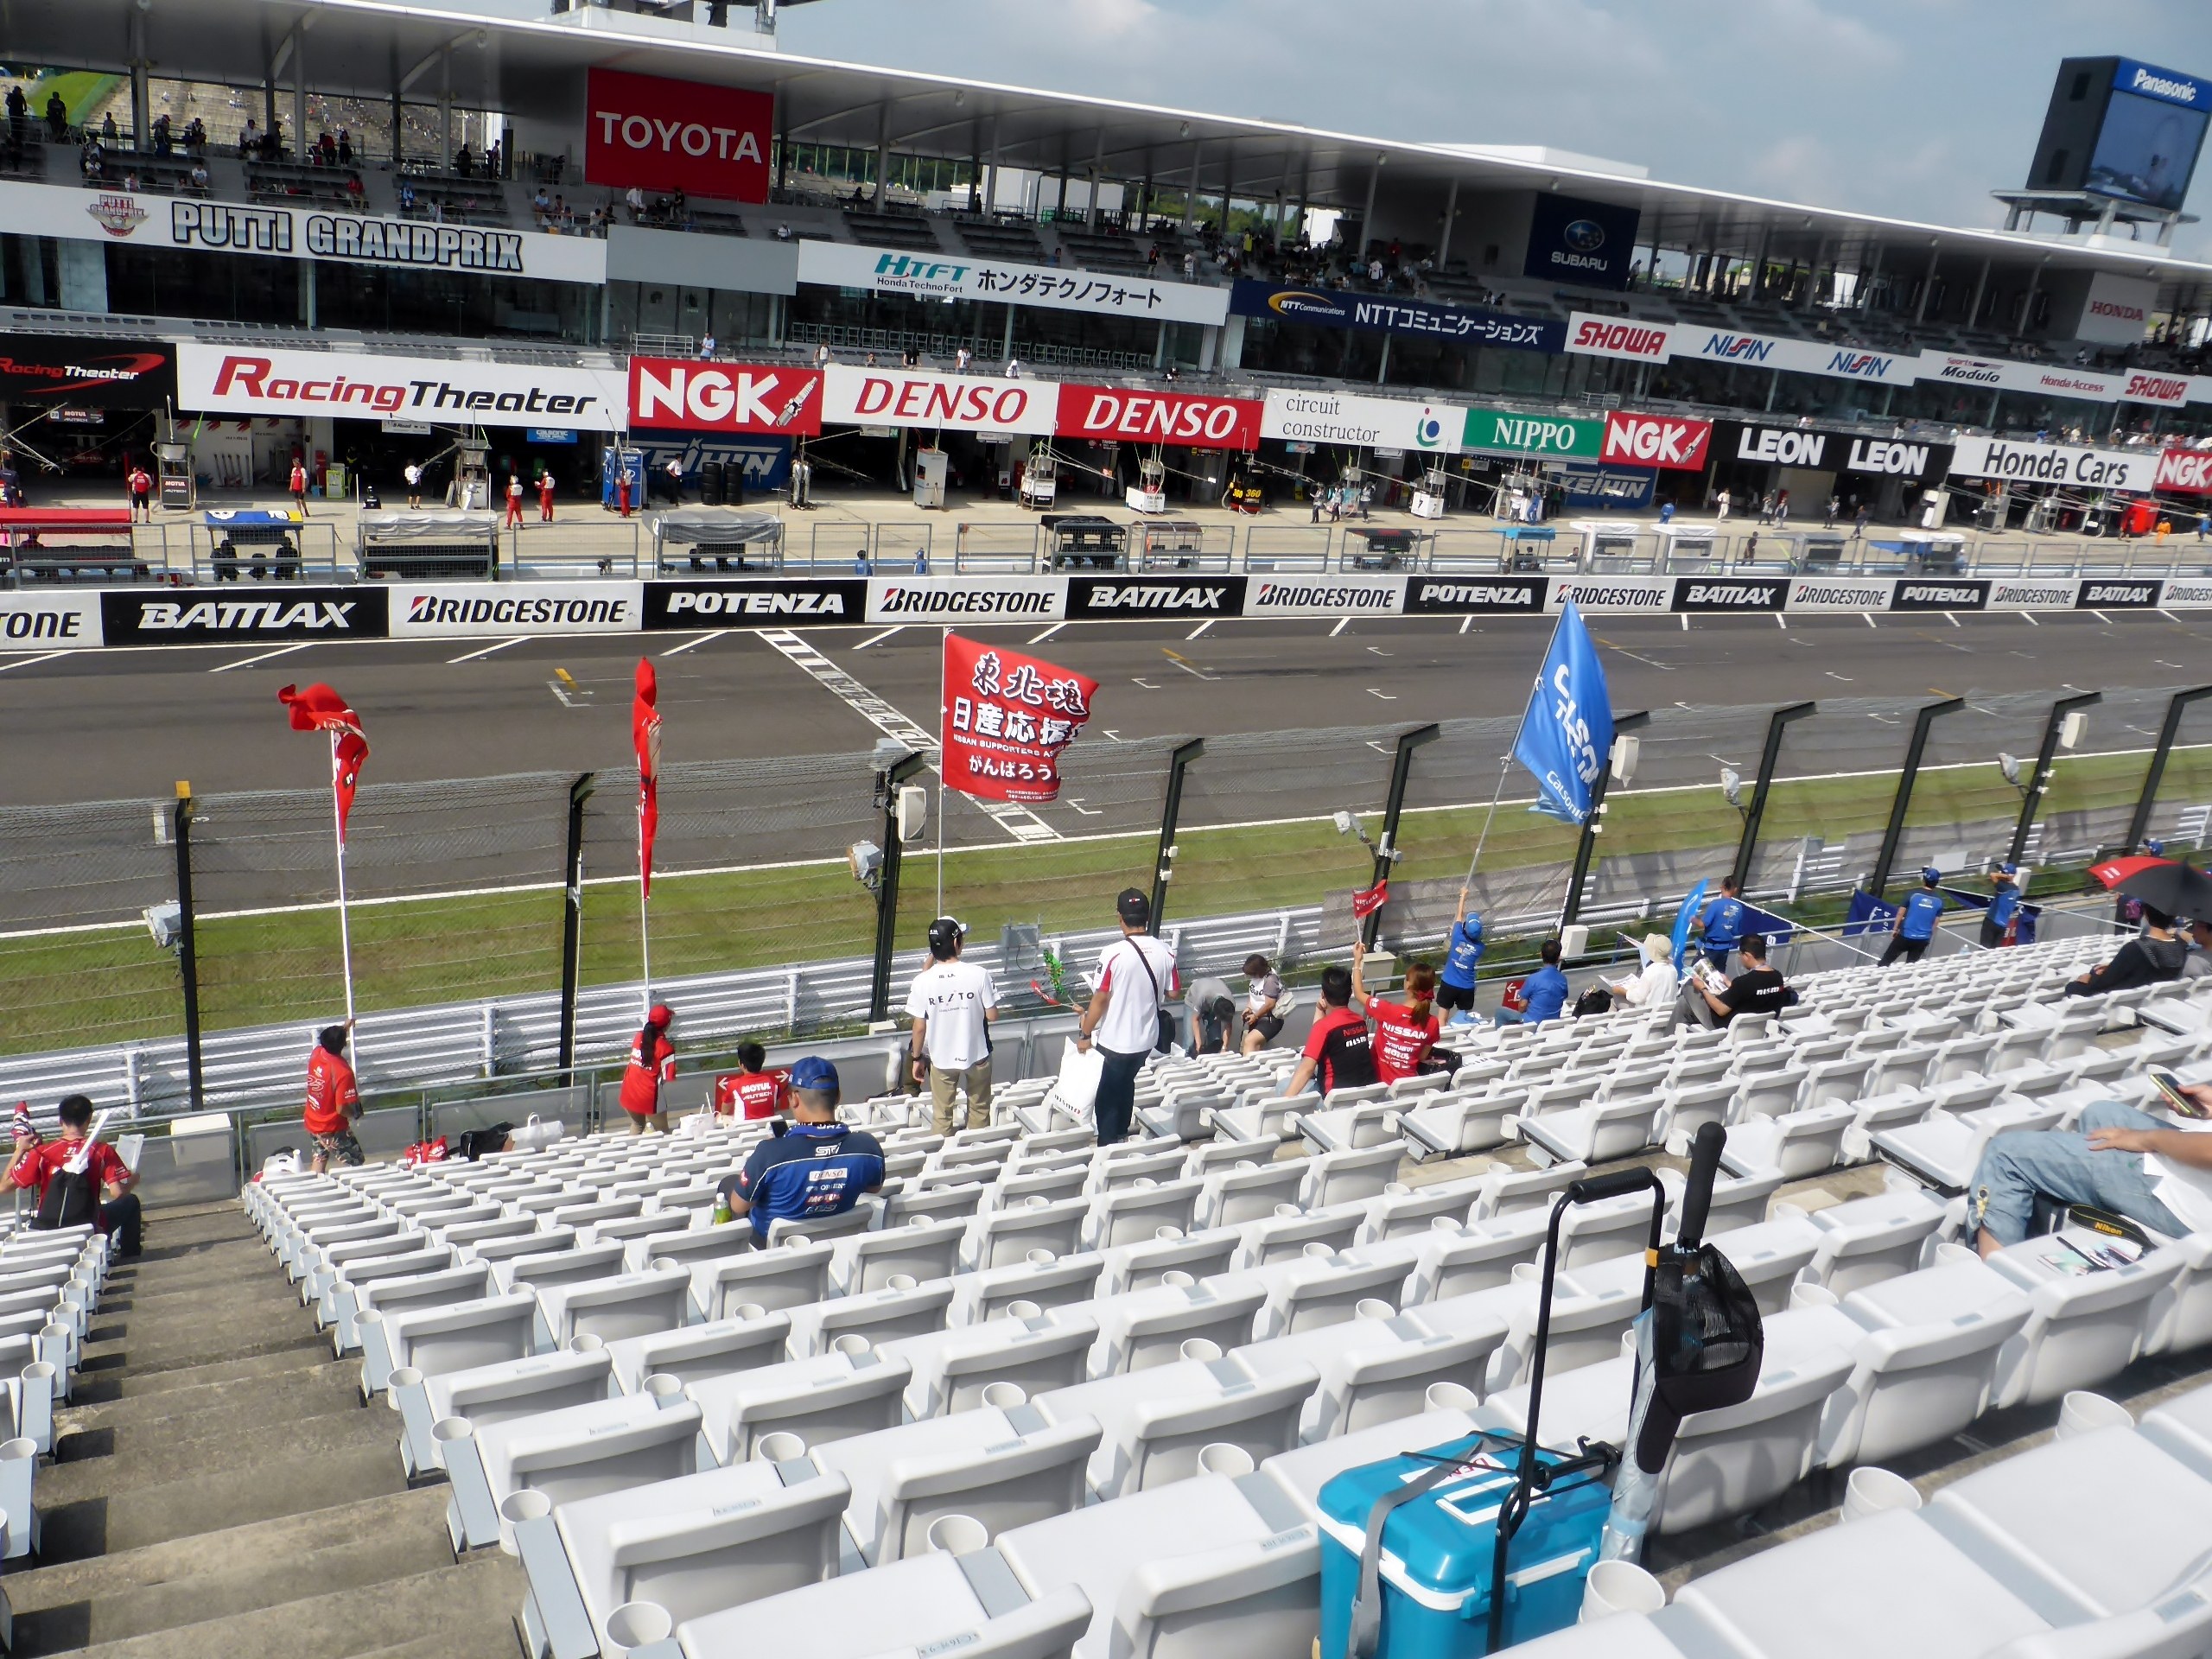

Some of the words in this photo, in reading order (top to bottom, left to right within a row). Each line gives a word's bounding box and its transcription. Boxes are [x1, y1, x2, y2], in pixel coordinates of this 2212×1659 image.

[2133, 68, 2196, 102] Panasonic
[596, 111, 762, 164] TOYOTA
[99, 194, 134, 208] PUTTI
[172, 201, 292, 251] PUTTI
[307, 215, 523, 272] GRANDPRIX
[874, 254, 971, 282] HTFT
[1551, 251, 1608, 271] SUBARU
[877, 276, 907, 288] Honda
[978, 270, 1161, 308] ホンダテクノフォート
[1281, 300, 1300, 310] NTT
[1300, 303, 1345, 316] Communications
[2089, 301, 2144, 322] HONDA
[1356, 302, 1543, 345] NTTコミュニケーションズ
[1573, 321, 1667, 356] SHOWA
[1947, 357, 1974, 366] Sports
[1941, 365, 2001, 383] Modulo
[2040, 374, 2072, 389] Honda
[2072, 379, 2104, 392] Access
[639, 367, 779, 426] NGK
[2125, 375, 2188, 400] SHOWA
[855, 378, 1027, 423] DENSO
[1286, 395, 1340, 416] circuit
[1084, 392, 1238, 439] DENSO
[1282, 418, 1381, 443] constructor
[1492, 418, 1576, 450] NIPPO
[1605, 417, 1688, 464] NGK
[1737, 428, 1825, 466] LEON
[1847, 440, 1929, 475] LEON
[1983, 443, 2067, 480] Honda
[2075, 452, 2129, 486] Cars
[2158, 454, 2212, 488] NGK
[1246, 489, 1262, 499] 360
[1418, 499, 1424, 509] 7
[666, 592, 845, 614] POTENZA
[882, 587, 1054, 614] BRIDGESTONE
[1089, 585, 1226, 608] BATTLAX
[1255, 583, 1396, 607] BRIDGESTONE
[1419, 584, 1532, 605] POTENZA
[1554, 584, 1667, 607] BRIDGESTONE
[1686, 585, 1777, 605] BATTLAX
[1796, 585, 1887, 606] BRIDGESTONE
[1903, 586, 1981, 603] POTENZA
[1994, 586, 2074, 604] BRIDGESTONE
[2086, 587, 2154, 602] BATTLAX
[2164, 585, 2212, 601] BRIDGES
[137, 601, 357, 630] BATTLAX
[407, 594, 629, 624] BRIDGESTONE
[972, 651, 1087, 715] 東北魂
[953, 733, 977, 747] NISSAN
[979, 740, 1040, 757] SUPPORTERS
[969, 754, 1052, 781] がんばろう
[1382, 1020, 1428, 1040] NISSAN
[741, 1082, 772, 1094] MOTUL
[743, 1090, 772, 1101] AUTECH
[814, 1170, 843, 1179] DENSO
[2094, 1221, 2123, 1236] Nikon
